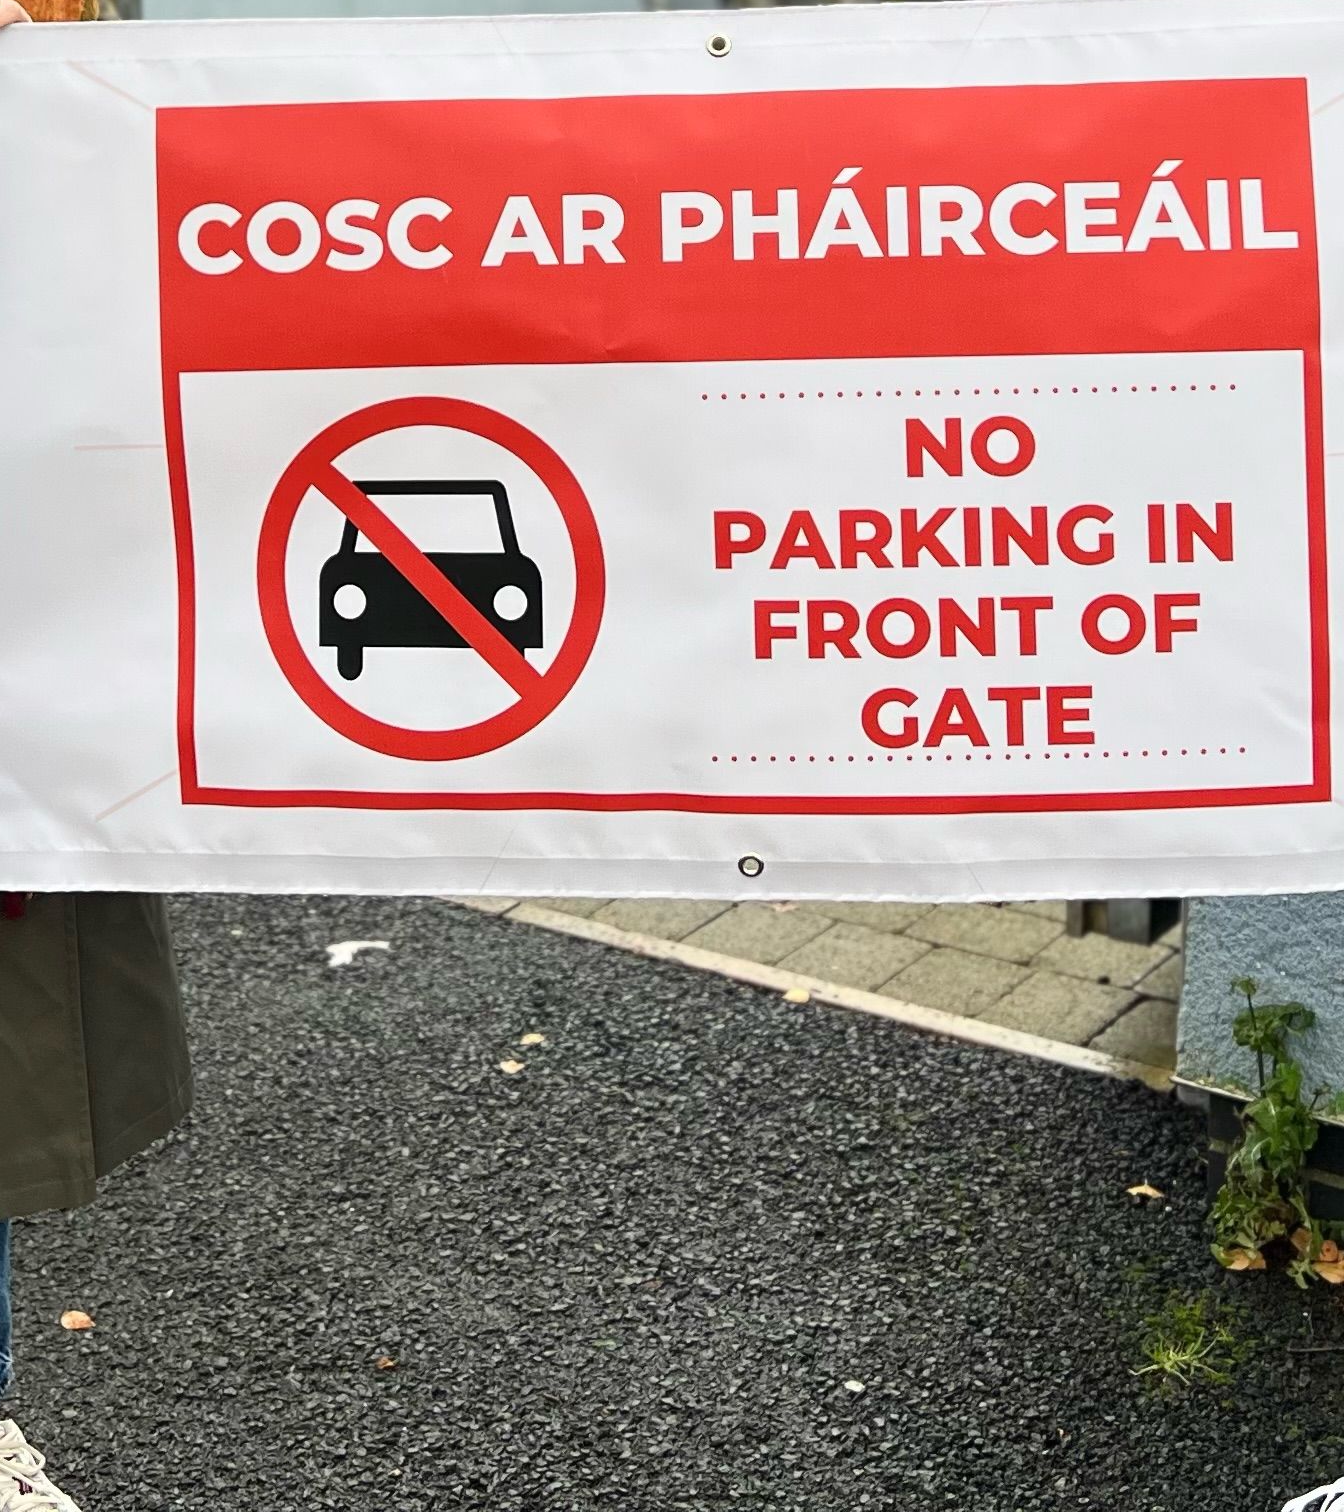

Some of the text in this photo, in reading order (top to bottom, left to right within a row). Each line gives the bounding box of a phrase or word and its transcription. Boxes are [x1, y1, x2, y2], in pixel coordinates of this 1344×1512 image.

[177, 159, 1300, 276] COSC AR PHÁIRCEÁIL
[905, 415, 1036, 478] NO
[712, 501, 1234, 570] PARKING IN
[752, 592, 1201, 660] FRONT OF
[860, 685, 1096, 749] GATE
